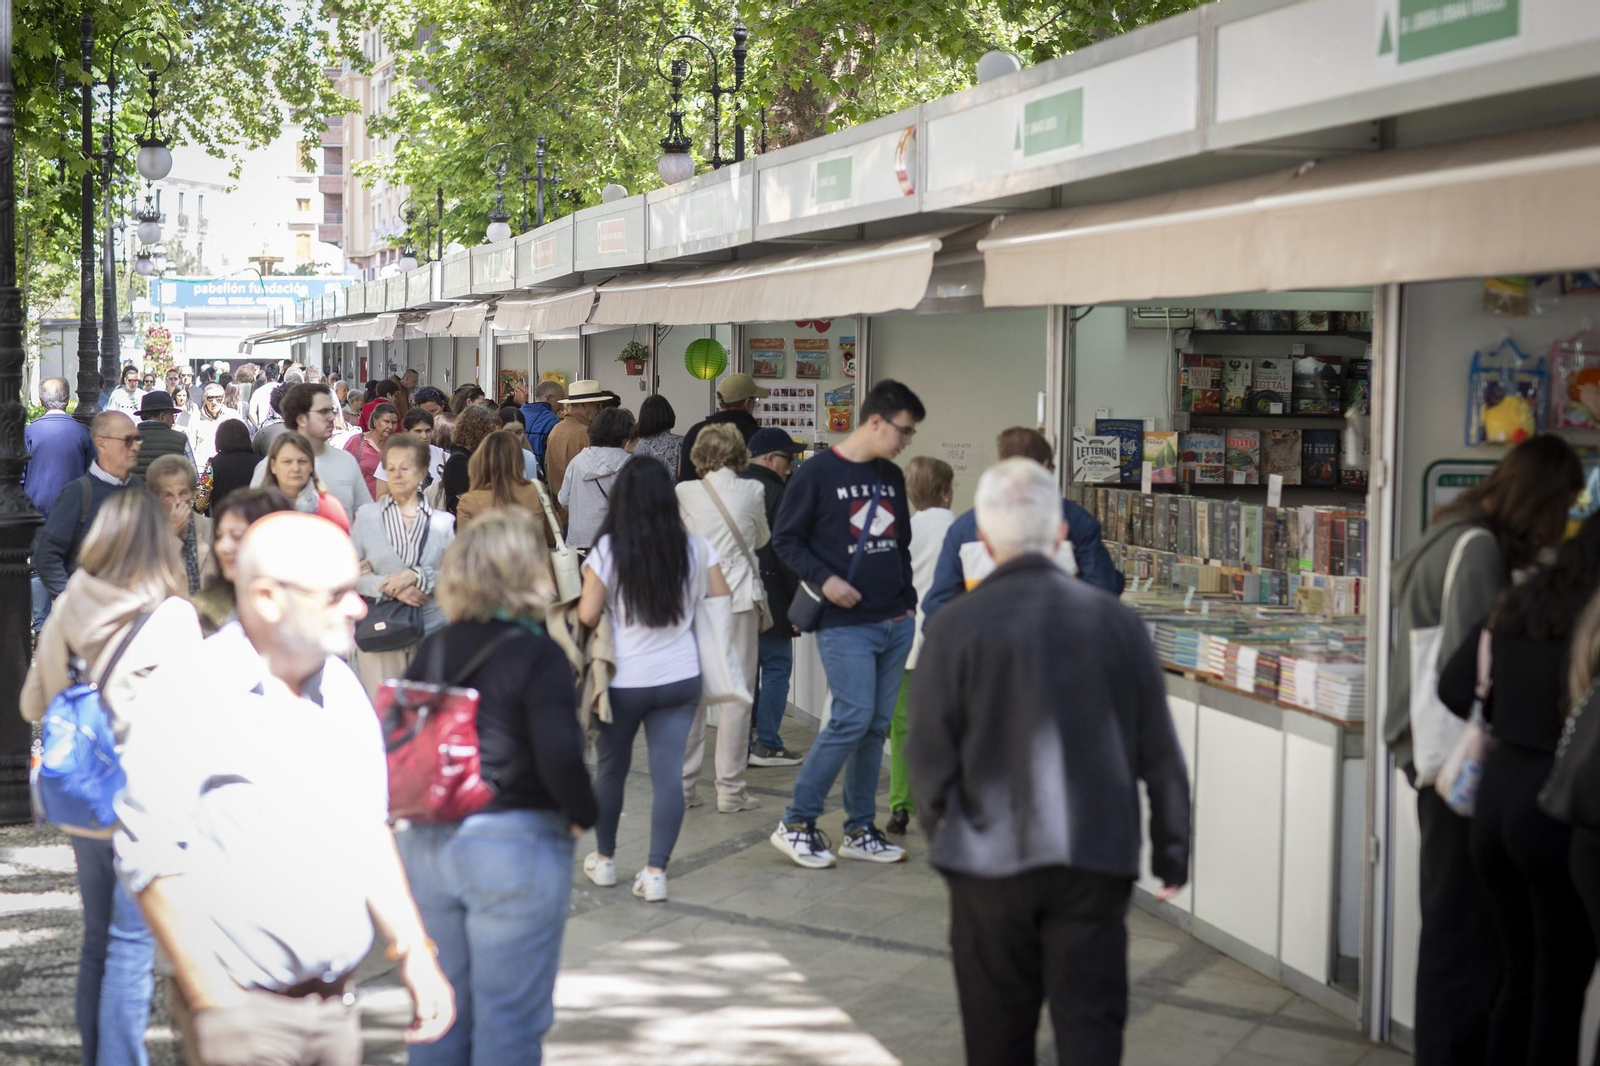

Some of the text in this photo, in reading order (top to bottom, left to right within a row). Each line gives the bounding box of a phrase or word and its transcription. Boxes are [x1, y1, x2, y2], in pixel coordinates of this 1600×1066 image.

[193, 281, 308, 296] pabellón fundación
[1191, 368, 1209, 377] 1001
[1181, 438, 1222, 450] PINTURA
[1077, 446, 1117, 461] LETTERING
[836, 484, 896, 500] MEXICO
